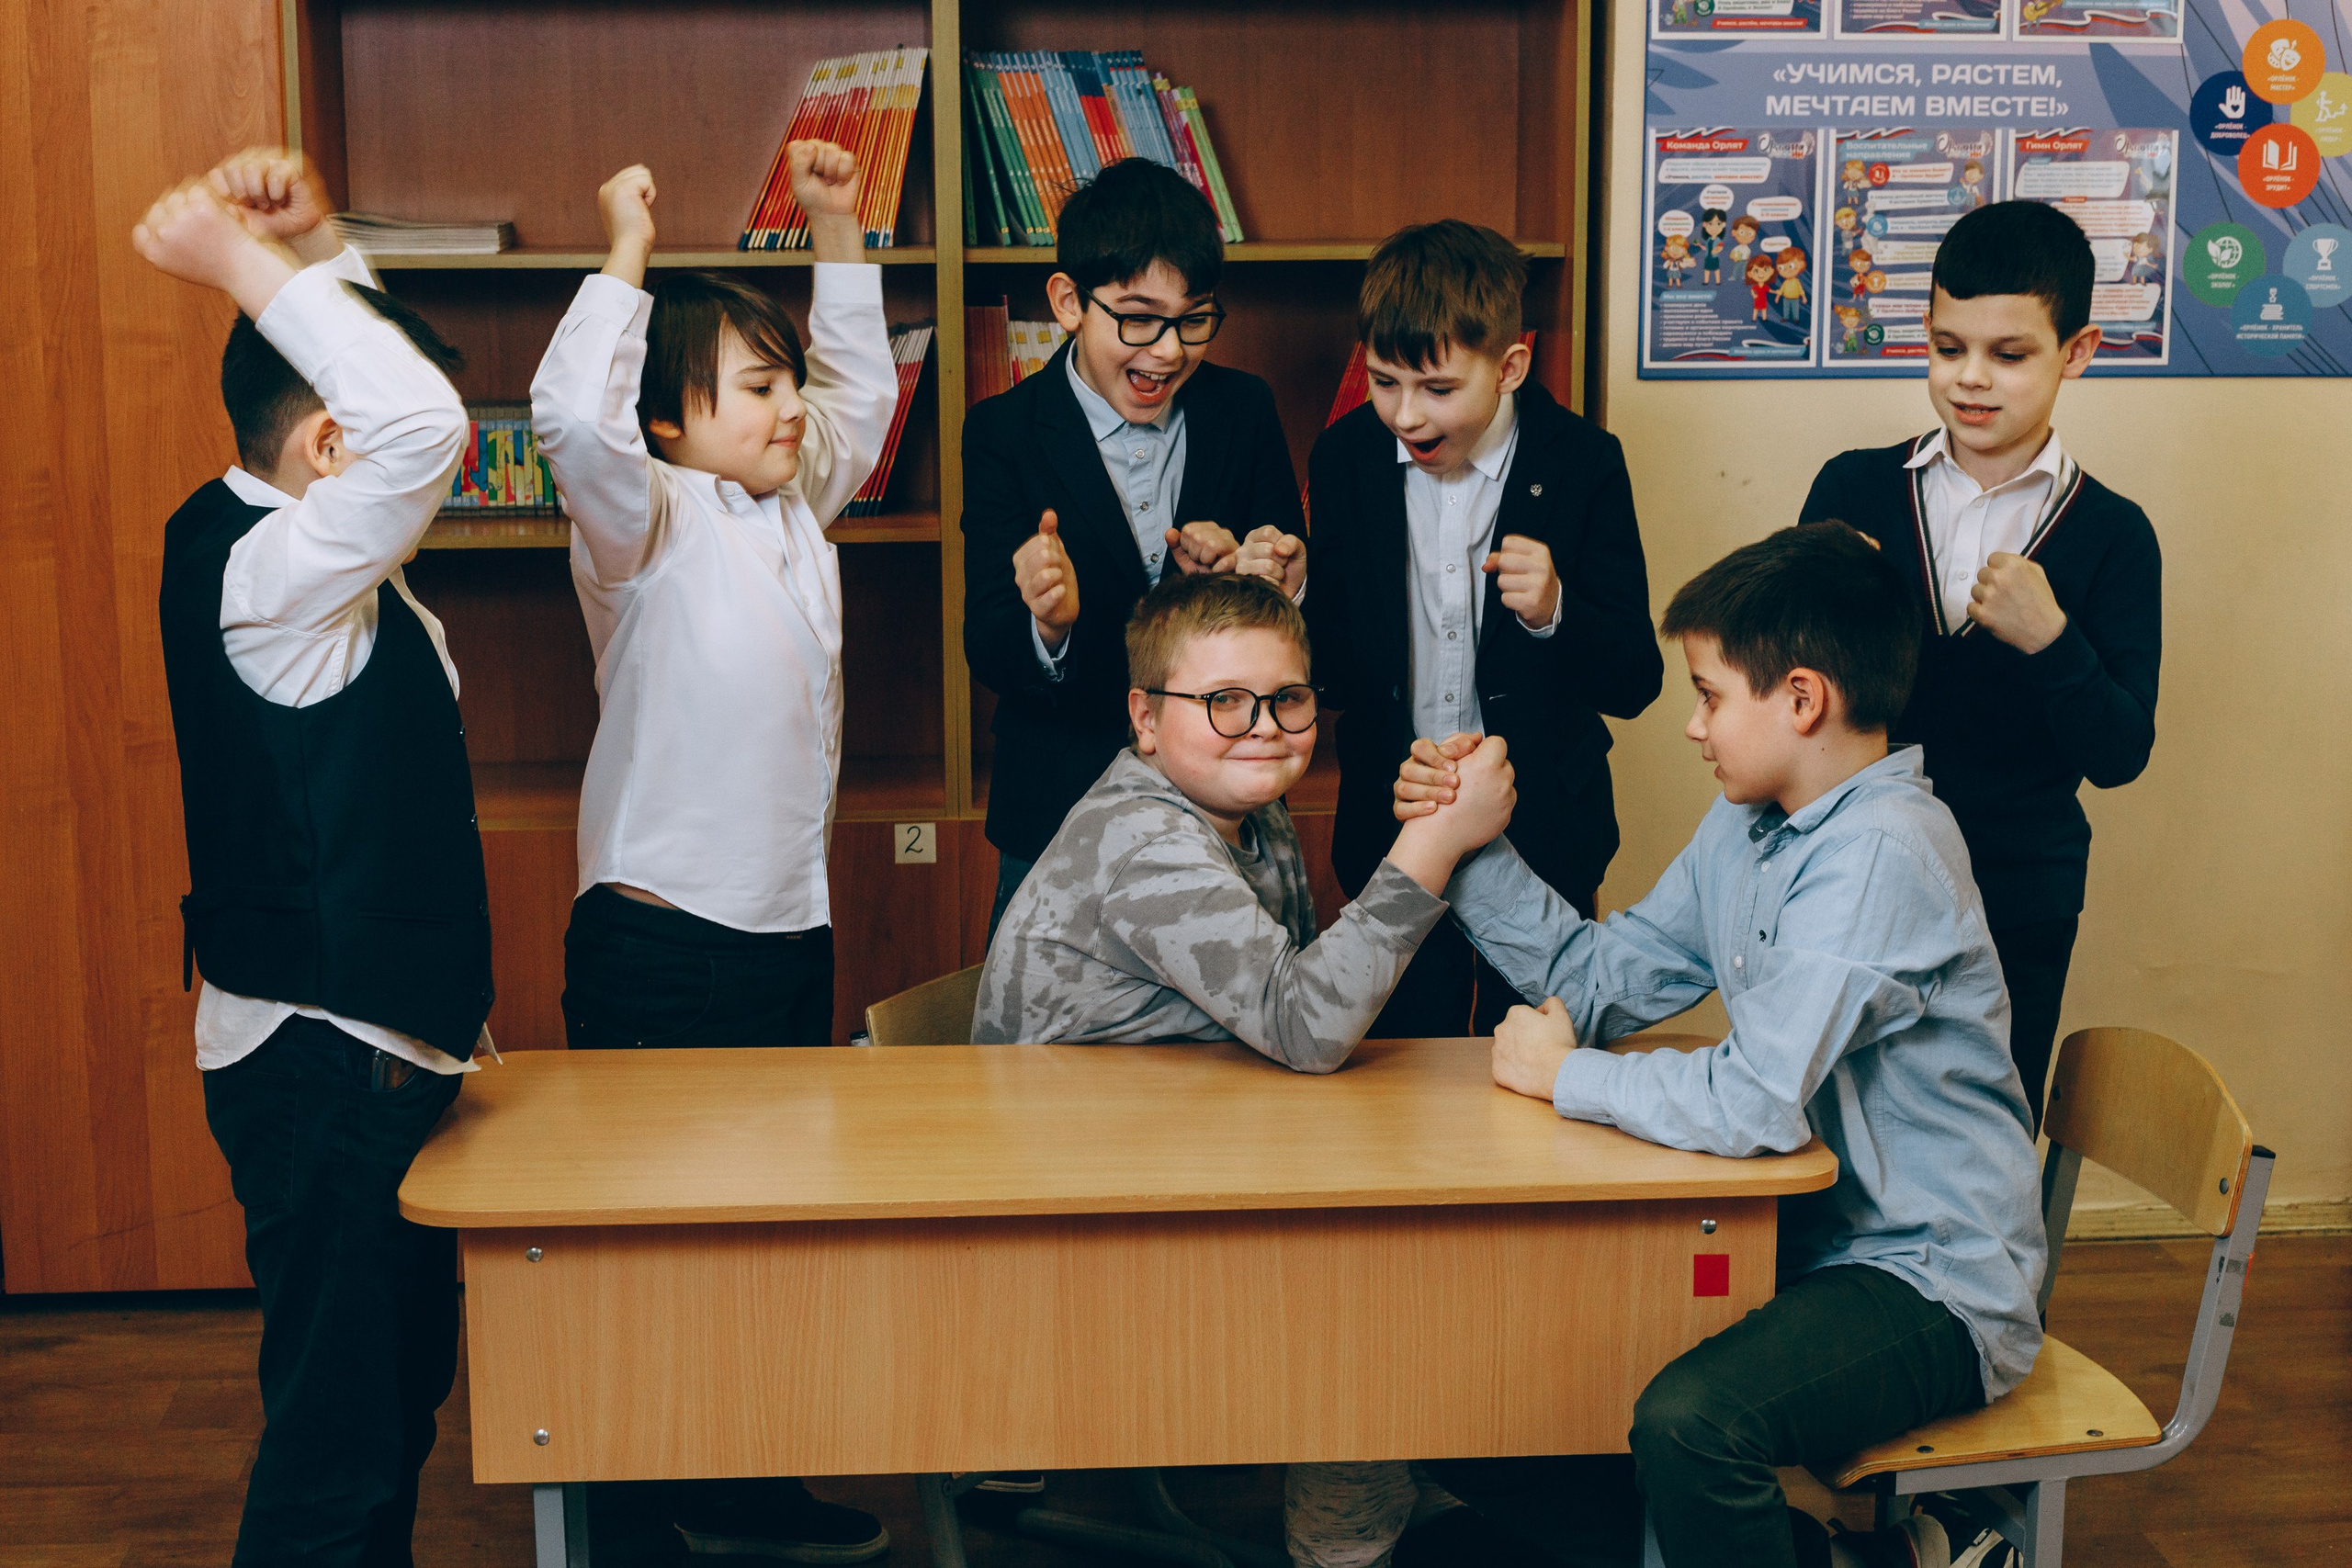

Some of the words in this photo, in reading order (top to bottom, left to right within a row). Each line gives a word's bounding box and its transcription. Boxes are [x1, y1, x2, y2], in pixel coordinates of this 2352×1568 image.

[1773, 63, 1921, 87] «УЧИМСЯ,
[1931, 64, 2063, 88] РАСТЕМ,
[1765, 96, 1916, 116] МЕЧТАЕМ
[1926, 96, 2069, 117] ВМЕСТЕ!»
[1666, 141, 1711, 151] Команда
[1712, 141, 1744, 152] Орлят
[1846, 141, 1928, 151] Воспитательные
[2025, 141, 2051, 150] Гимн
[2052, 141, 2084, 151] Орлят
[905, 825, 923, 853] 2
